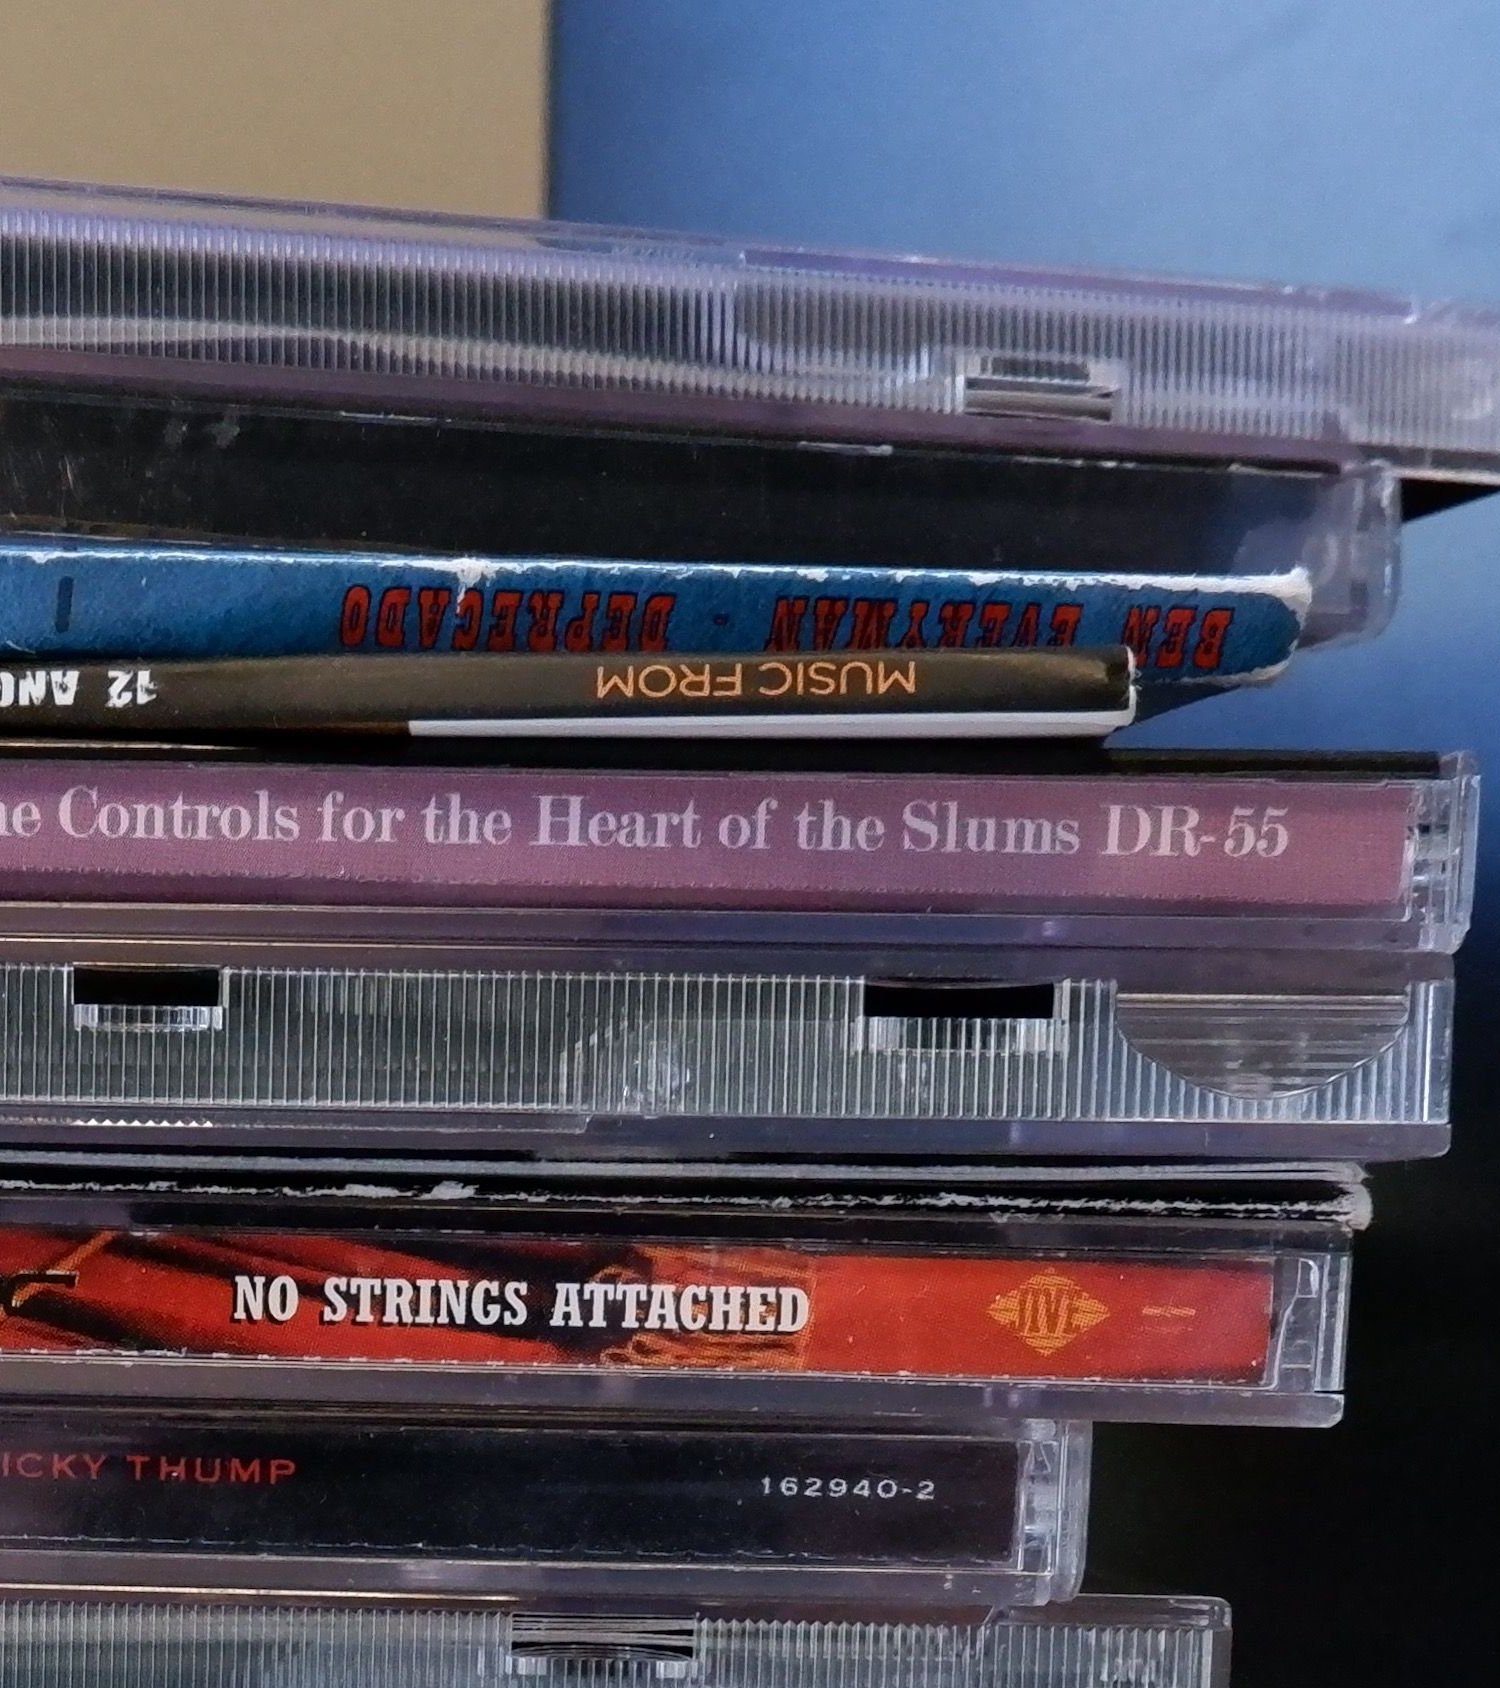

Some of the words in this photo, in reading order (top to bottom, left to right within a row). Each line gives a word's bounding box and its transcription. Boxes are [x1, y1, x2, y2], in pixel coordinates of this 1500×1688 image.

[339, 585, 676, 652] DEPRECADO
[1122, 606, 1235, 669] BEN
[105, 669, 158, 709] 12
[597, 664, 742, 698] FROM
[758, 661, 916, 696] MUSIC
[58, 785, 300, 842] Controls
[316, 792, 405, 843] for
[421, 793, 511, 846] the
[529, 794, 701, 850] Heart
[717, 799, 778, 850] of
[796, 799, 884, 852] the
[902, 799, 1080, 855] Slums
[1101, 804, 1289, 859] DR-55
[233, 1275, 299, 1323] NO
[322, 1276, 528, 1327] STRINGS
[550, 1281, 810, 1333] ATTACHED
[1, 1452, 108, 1482] ICKY
[125, 1454, 297, 1486] THUMP
[761, 1475, 935, 1500] 162940-2
